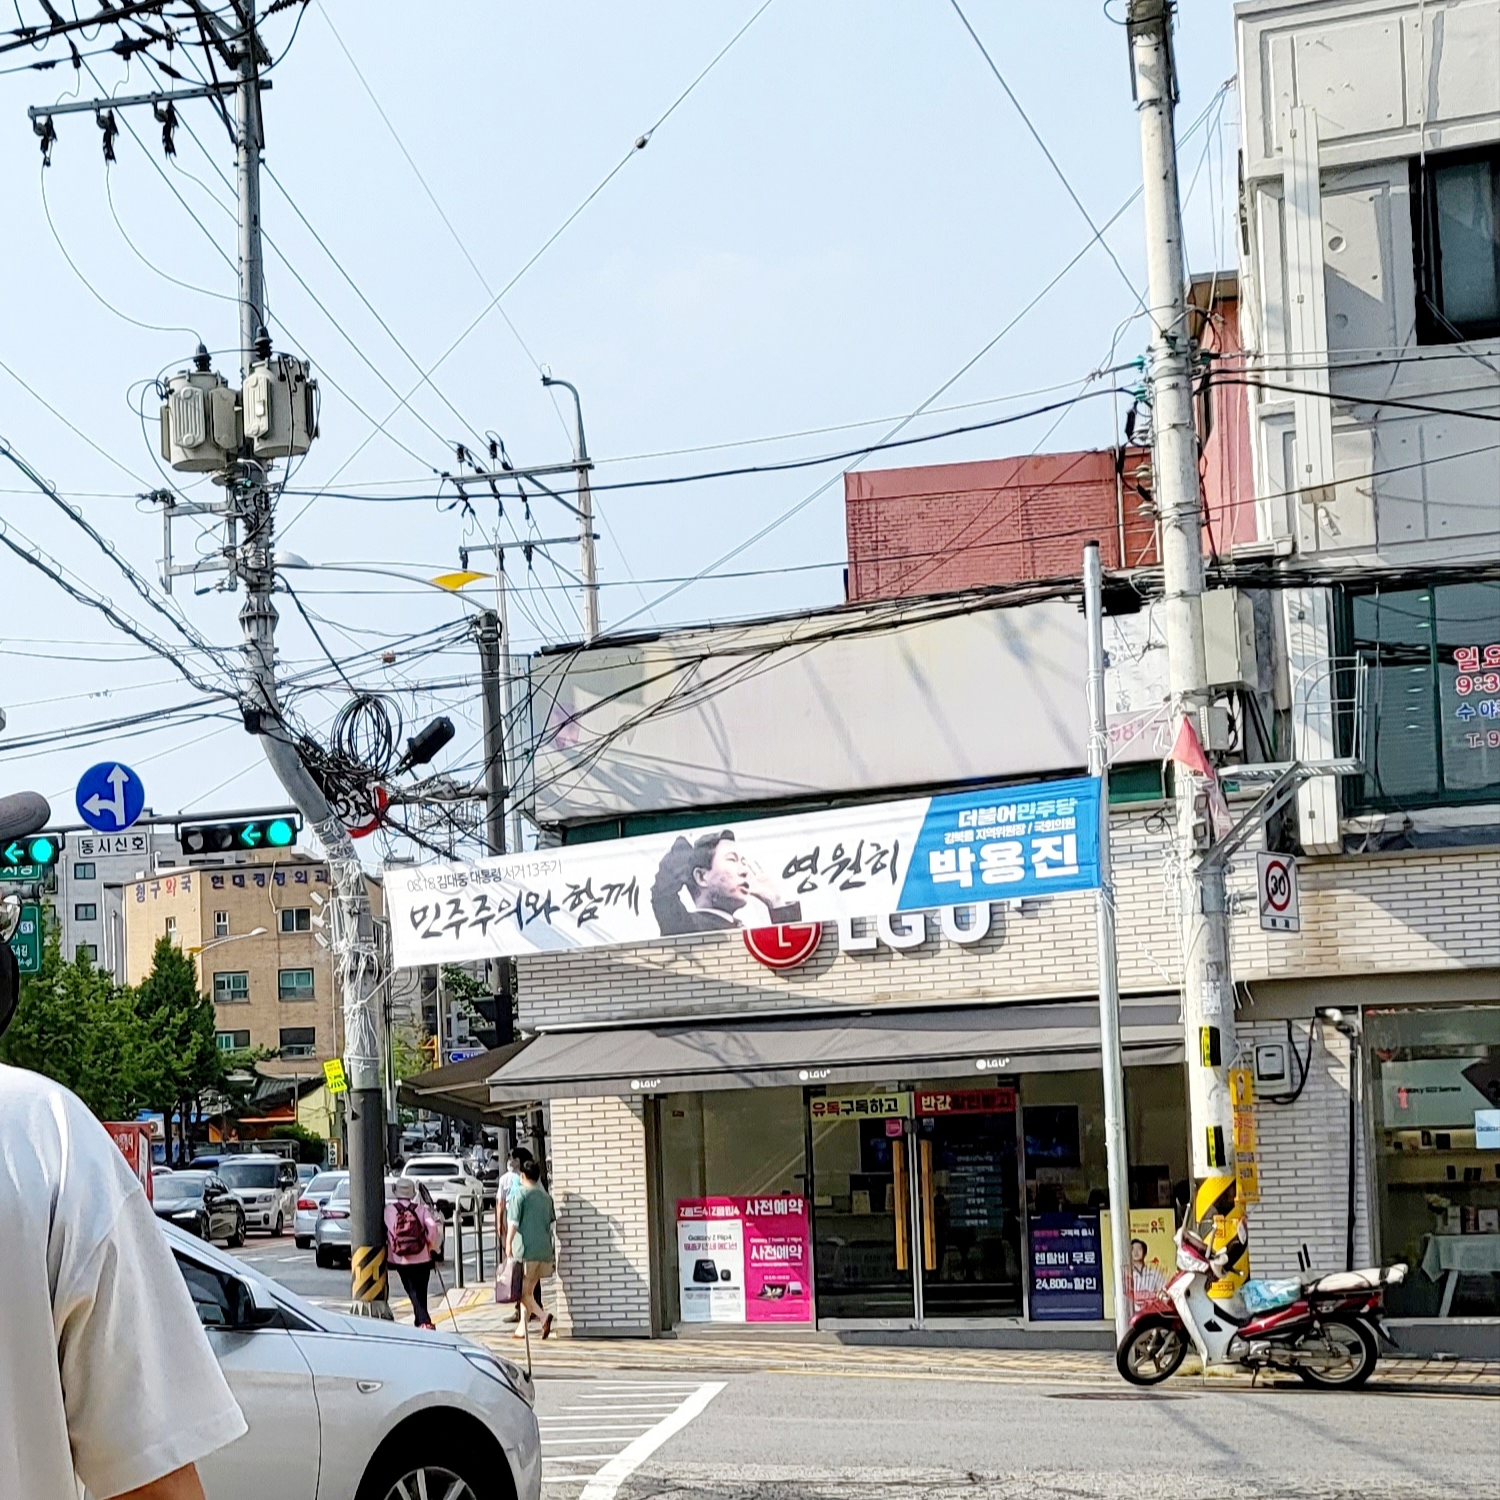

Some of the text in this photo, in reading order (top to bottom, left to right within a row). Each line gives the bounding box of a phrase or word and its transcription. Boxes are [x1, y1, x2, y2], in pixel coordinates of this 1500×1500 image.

[1455, 701, 1477, 722] 수
[957, 796, 1079, 828] 더불어민주당
[1033, 817, 1077, 834] 국회의원
[80, 836, 146, 855] 동시신호
[928, 833, 1081, 890] 박용진
[436, 873, 469, 890] 김대중
[469, 866, 502, 884] 대통령
[1270, 874, 1287, 896] 30
[409, 838, 900, 941] 민주주의와 함께 영원히
[921, 1094, 952, 1113] 반값
[744, 1198, 804, 1216] 사전예약
[750, 1244, 803, 1261] 사전예약
[1072, 1251, 1096, 1264] 무료
[1073, 1277, 1097, 1290] 할인
